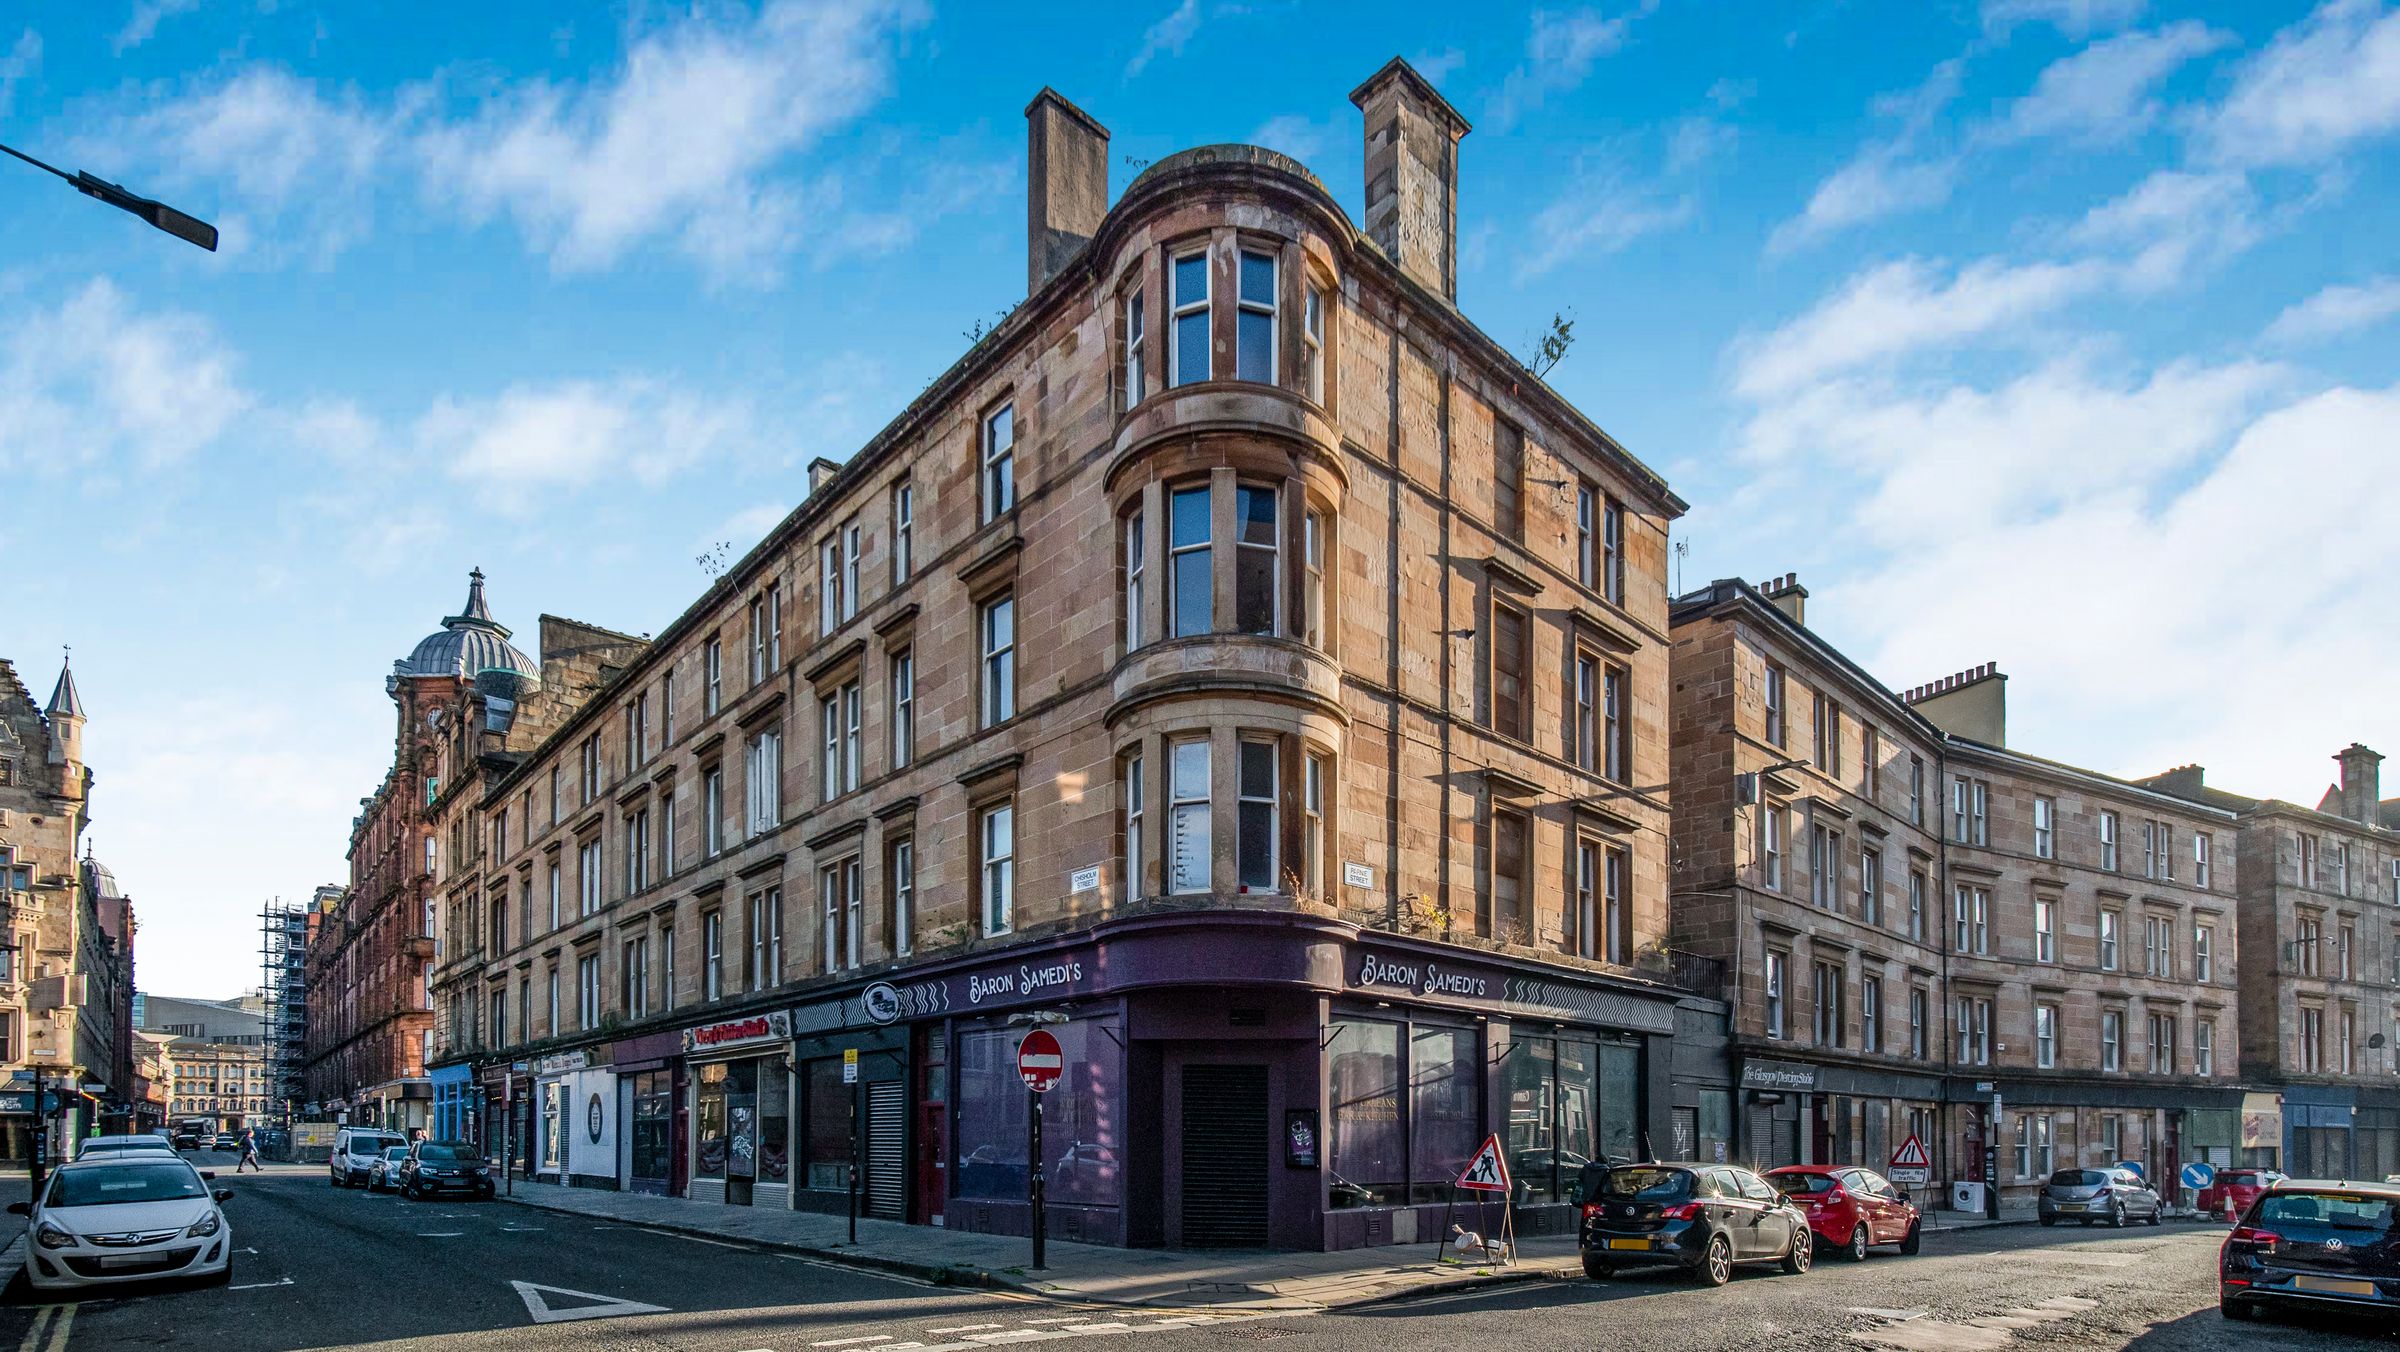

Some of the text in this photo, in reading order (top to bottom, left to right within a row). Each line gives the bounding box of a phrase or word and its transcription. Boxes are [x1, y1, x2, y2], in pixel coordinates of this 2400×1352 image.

[1074, 871, 1097, 882] CHISHOLM
[1350, 875, 1368, 884] STREET
[1077, 879, 1094, 889] STREET
[1360, 1097, 1397, 1108] ORLEANS
